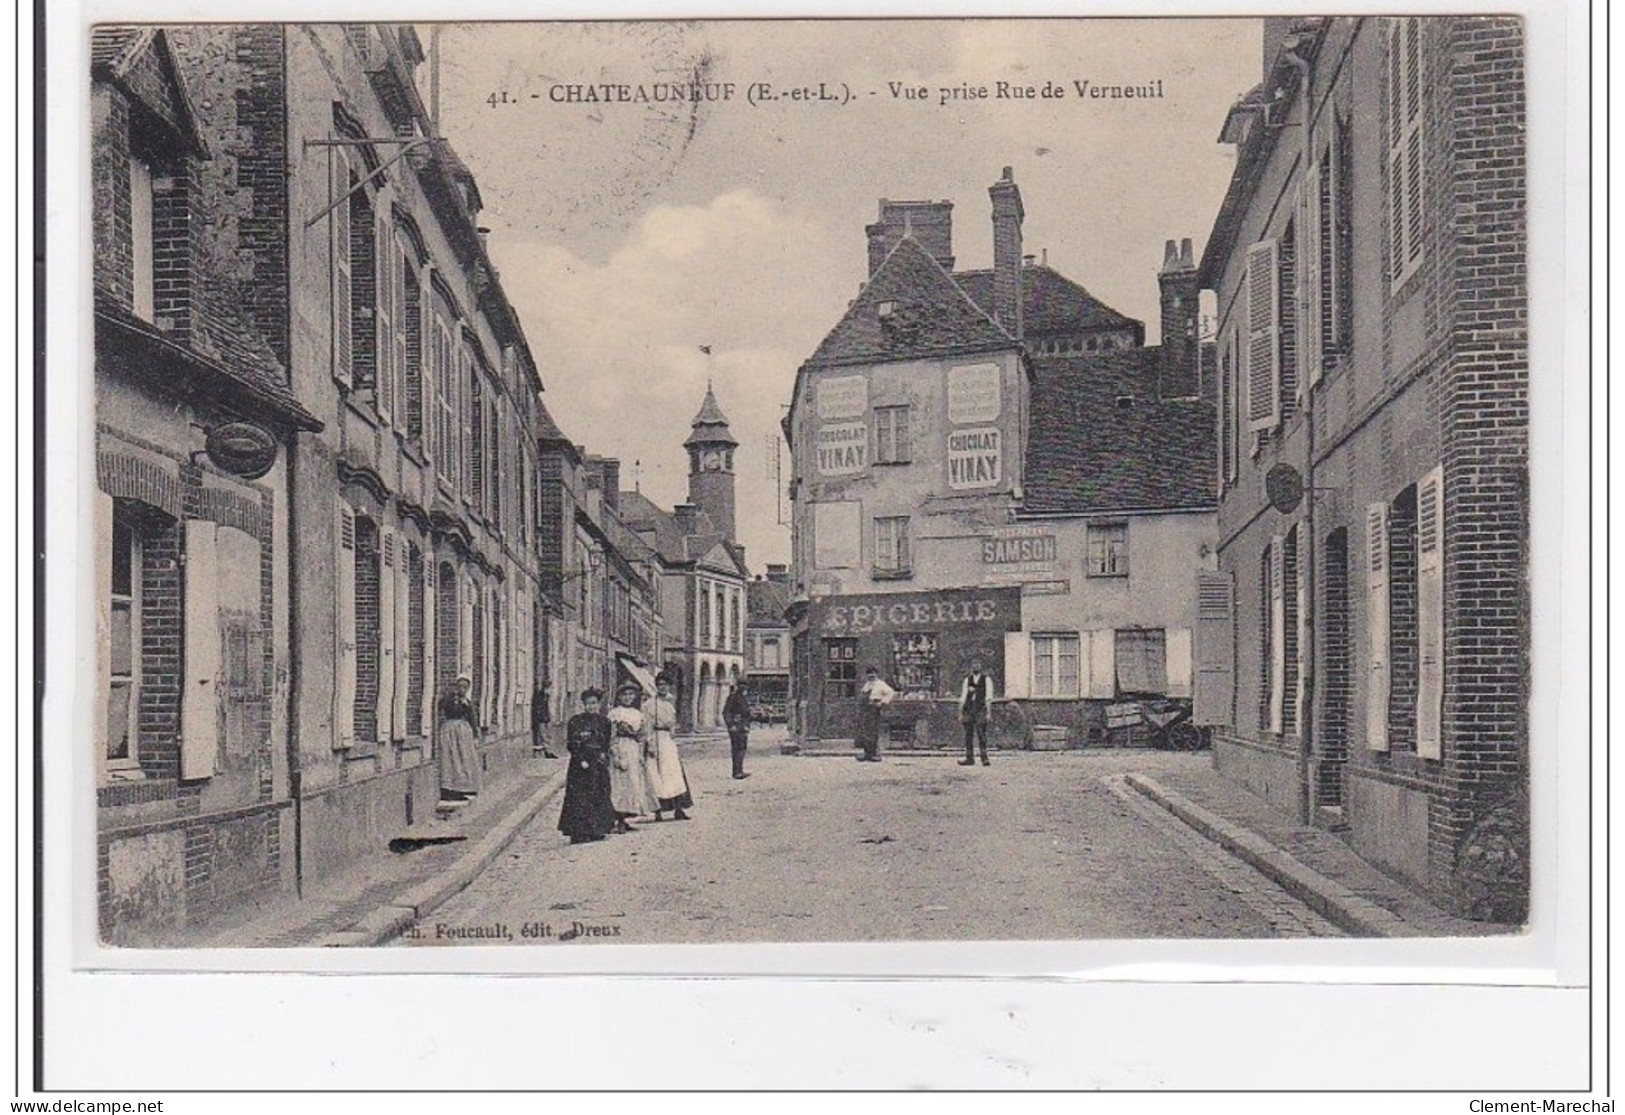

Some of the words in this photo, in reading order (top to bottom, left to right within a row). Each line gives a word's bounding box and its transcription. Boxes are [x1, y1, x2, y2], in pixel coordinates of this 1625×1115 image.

[950, 432, 997, 451] CHOCOLAT
[818, 445, 866, 470] VINAY
[950, 455, 997, 483] VINAY
